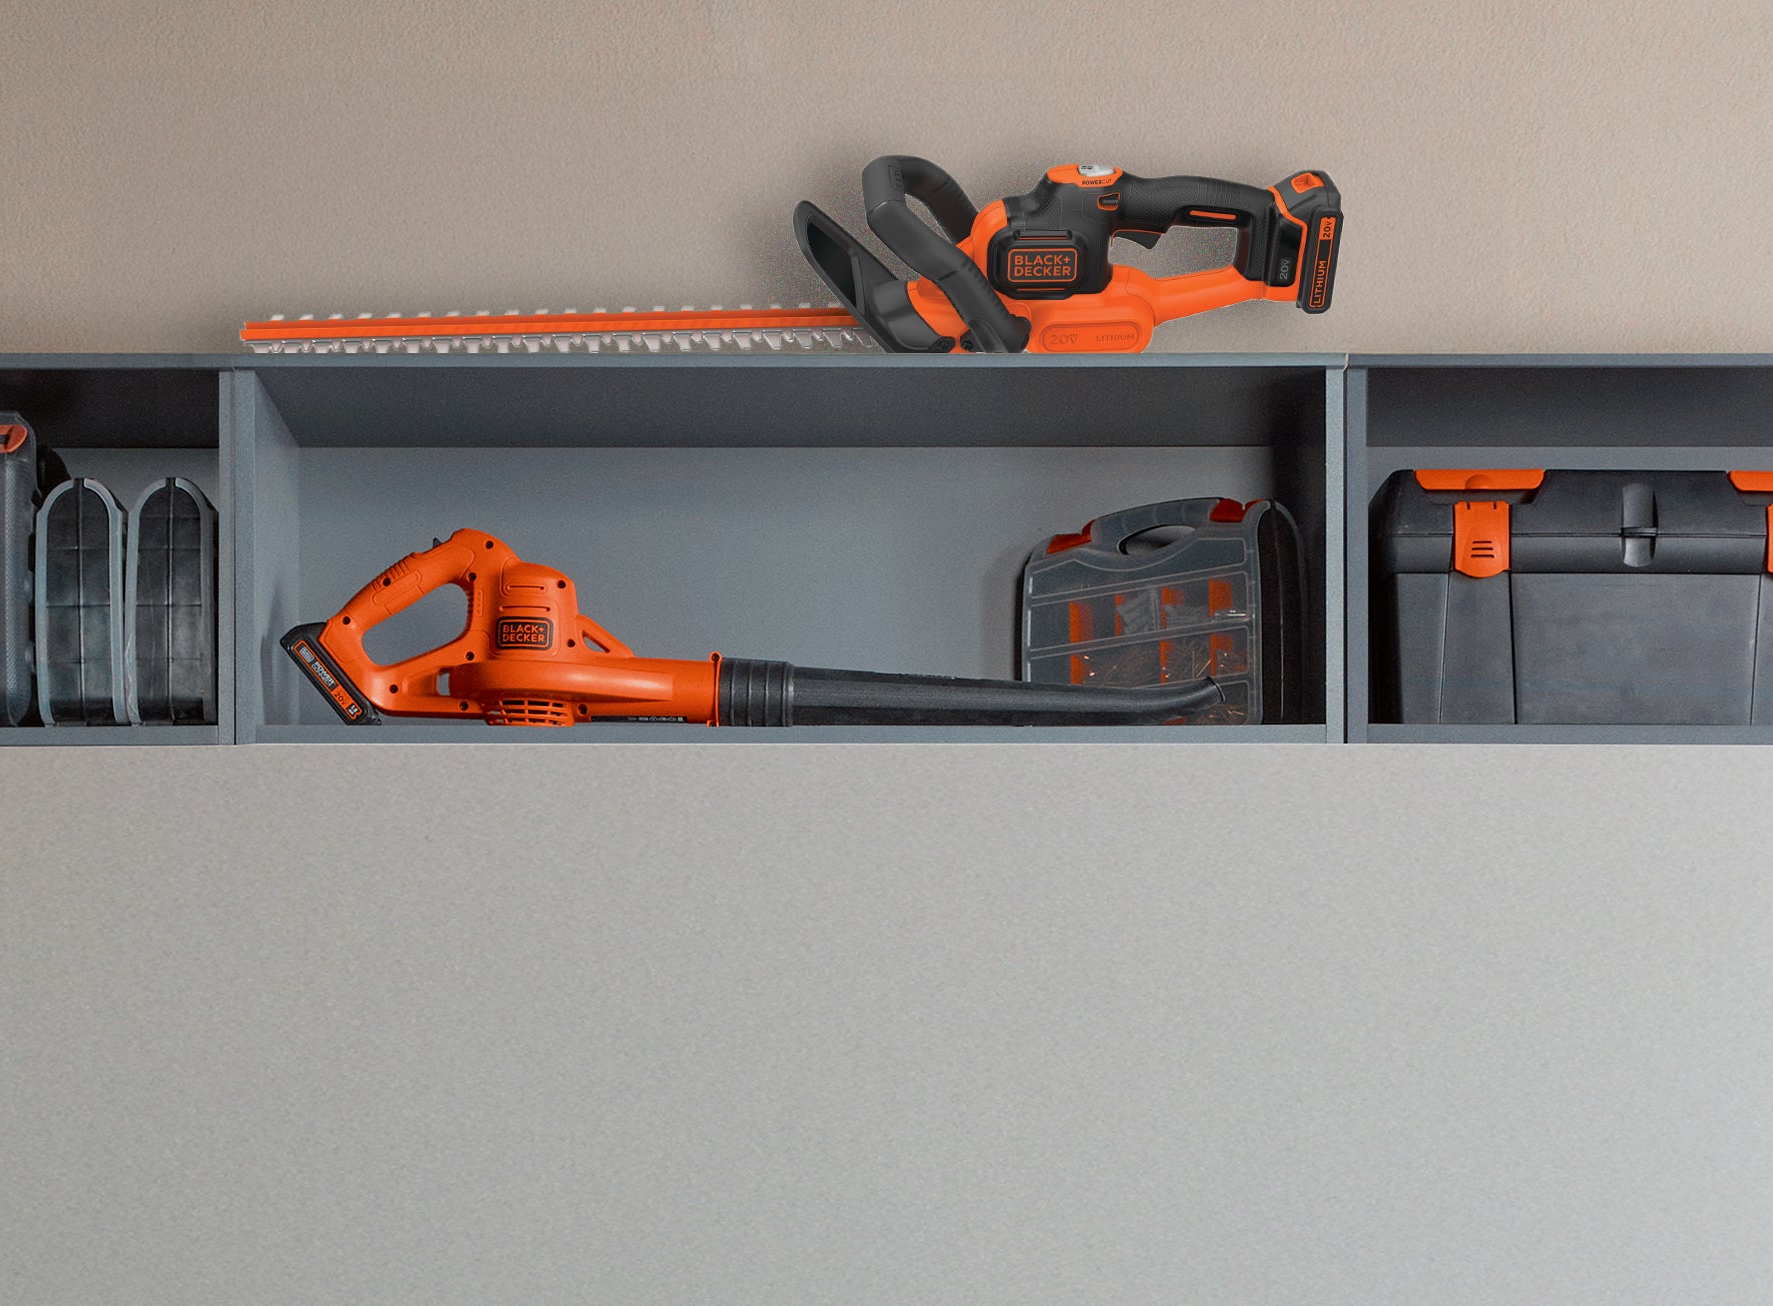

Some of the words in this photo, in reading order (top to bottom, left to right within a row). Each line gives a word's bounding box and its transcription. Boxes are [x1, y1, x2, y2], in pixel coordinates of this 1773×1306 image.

[1013, 254, 1071, 266] BLACK+
[1013, 265, 1072, 277] DECKER
[1313, 260, 1327, 304] LITHIUM
[1095, 333, 1135, 342] LITHIUM
[502, 624, 545, 633] BLACK+
[502, 633, 545, 642] DECKER
